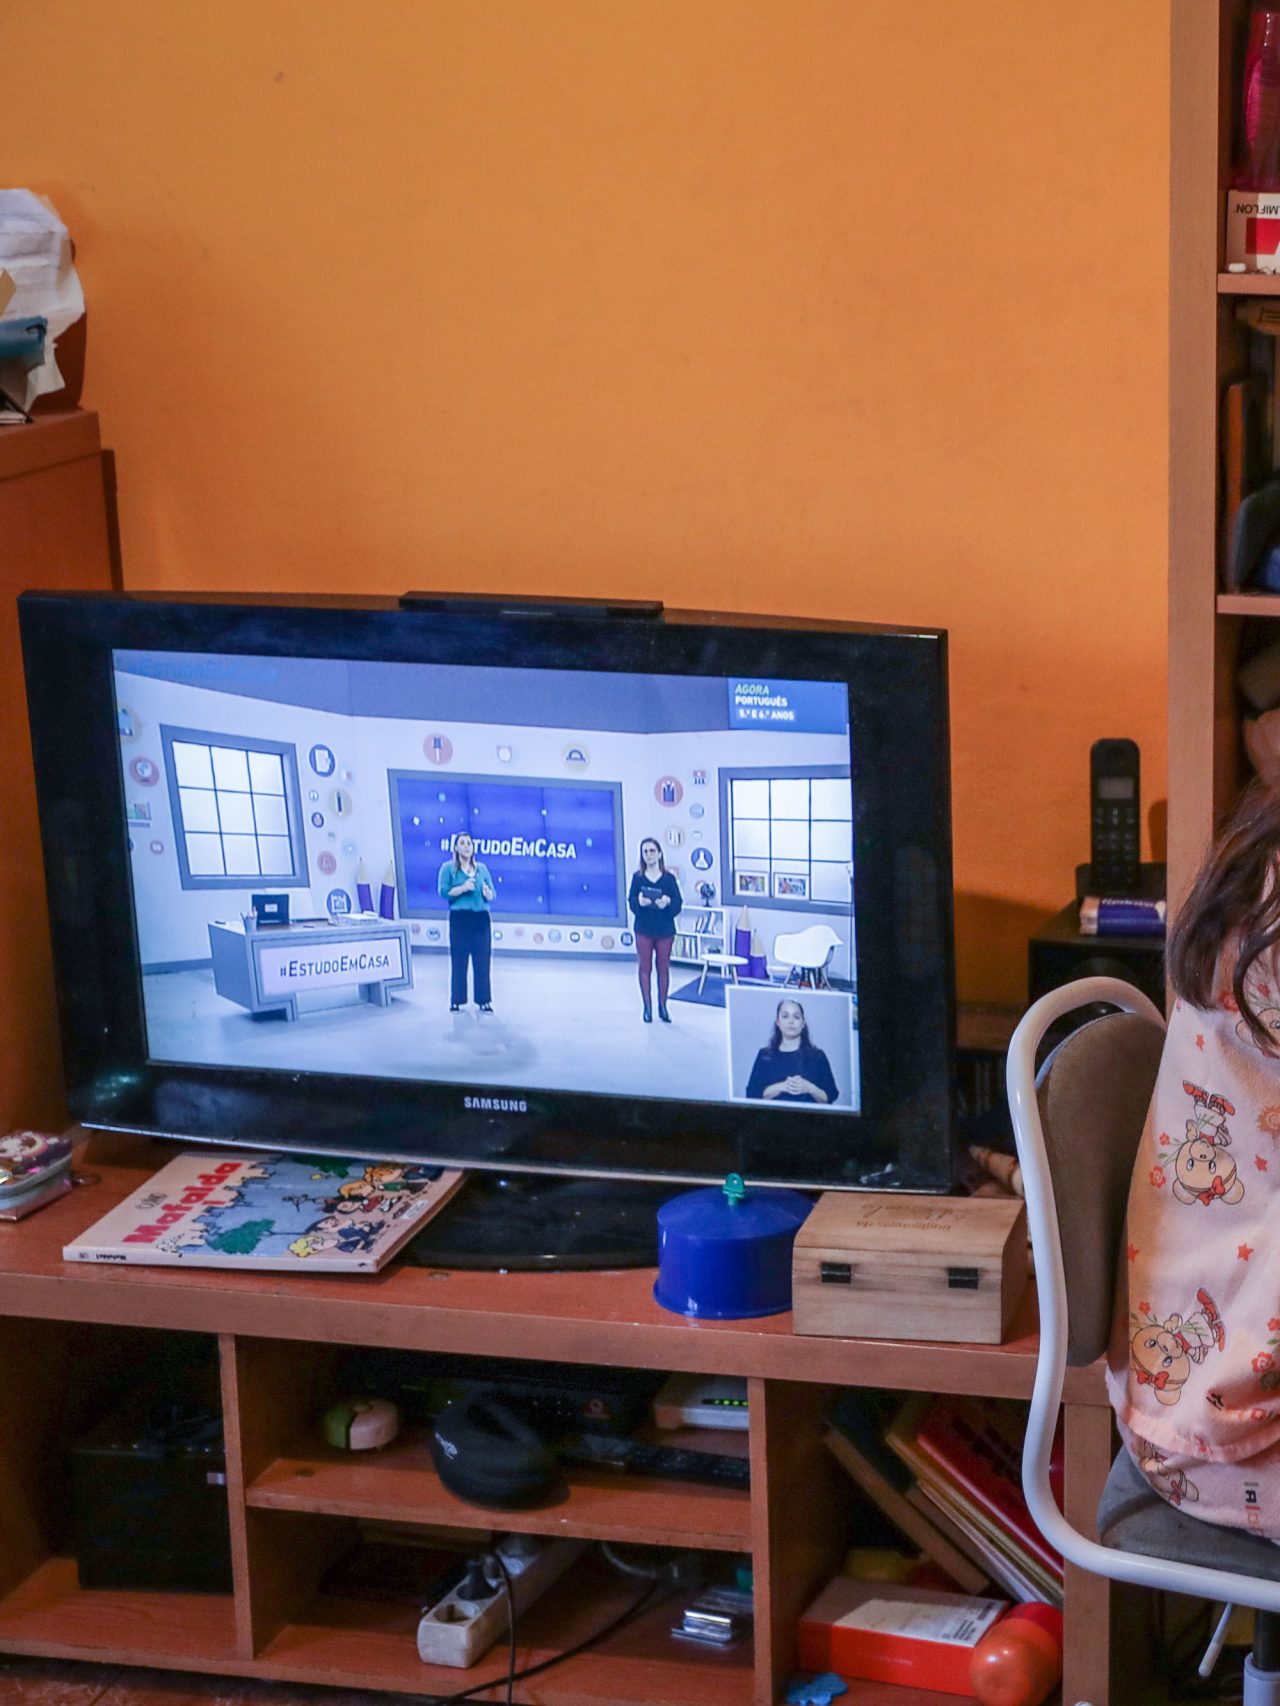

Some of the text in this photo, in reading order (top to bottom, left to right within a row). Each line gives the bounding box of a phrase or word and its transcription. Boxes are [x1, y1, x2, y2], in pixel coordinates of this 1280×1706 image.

[735, 684, 769, 695] AGORA
[735, 696, 788, 707] PORTUGUÊS
[771, 710, 794, 720] ANOS
[464, 1097, 527, 1112] SAMSUNG
[122, 1162, 242, 1243] Mafalda
